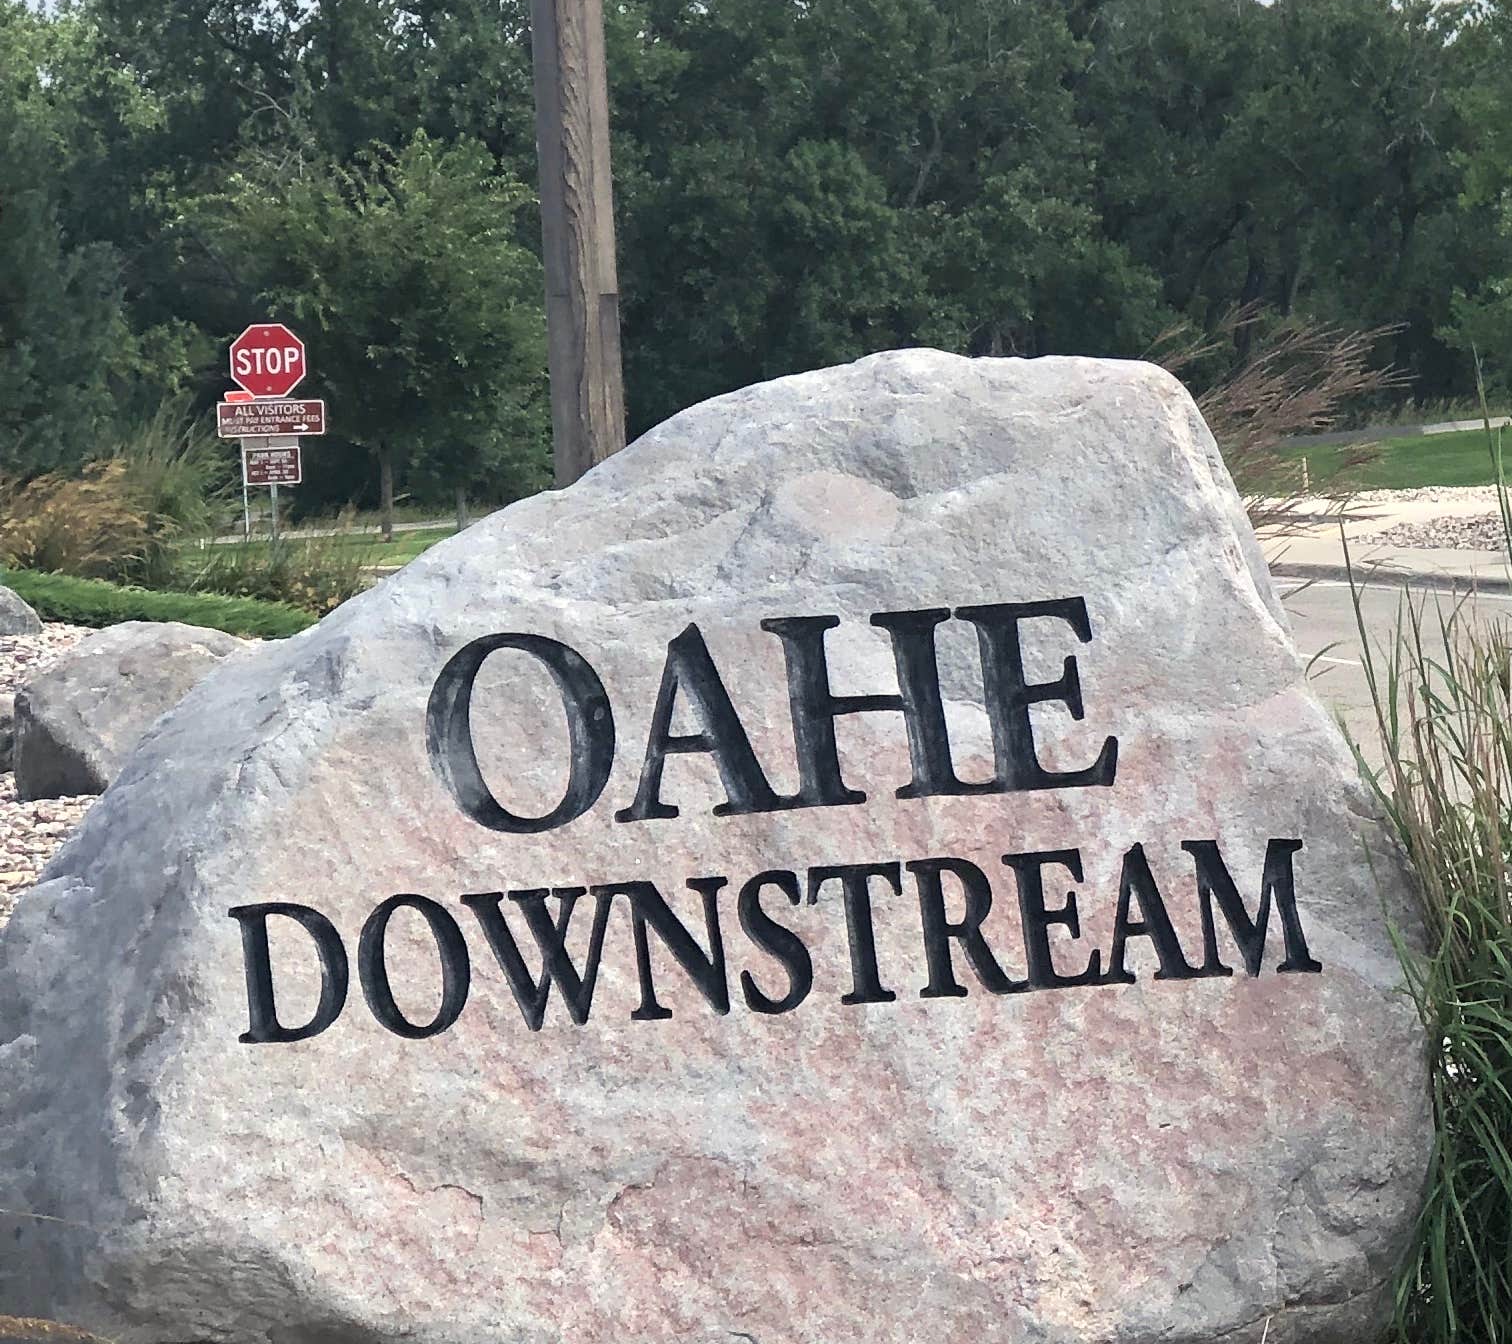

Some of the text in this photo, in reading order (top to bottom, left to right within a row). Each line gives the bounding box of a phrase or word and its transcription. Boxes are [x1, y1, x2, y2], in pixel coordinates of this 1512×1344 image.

[236, 347, 300, 376] STOP
[235, 404, 306, 416] ALL VISITORS
[261, 415, 301, 424] ENTRANCE
[426, 596, 1118, 834] OAHE
[228, 838, 1322, 1043] DOWNSTREAM
